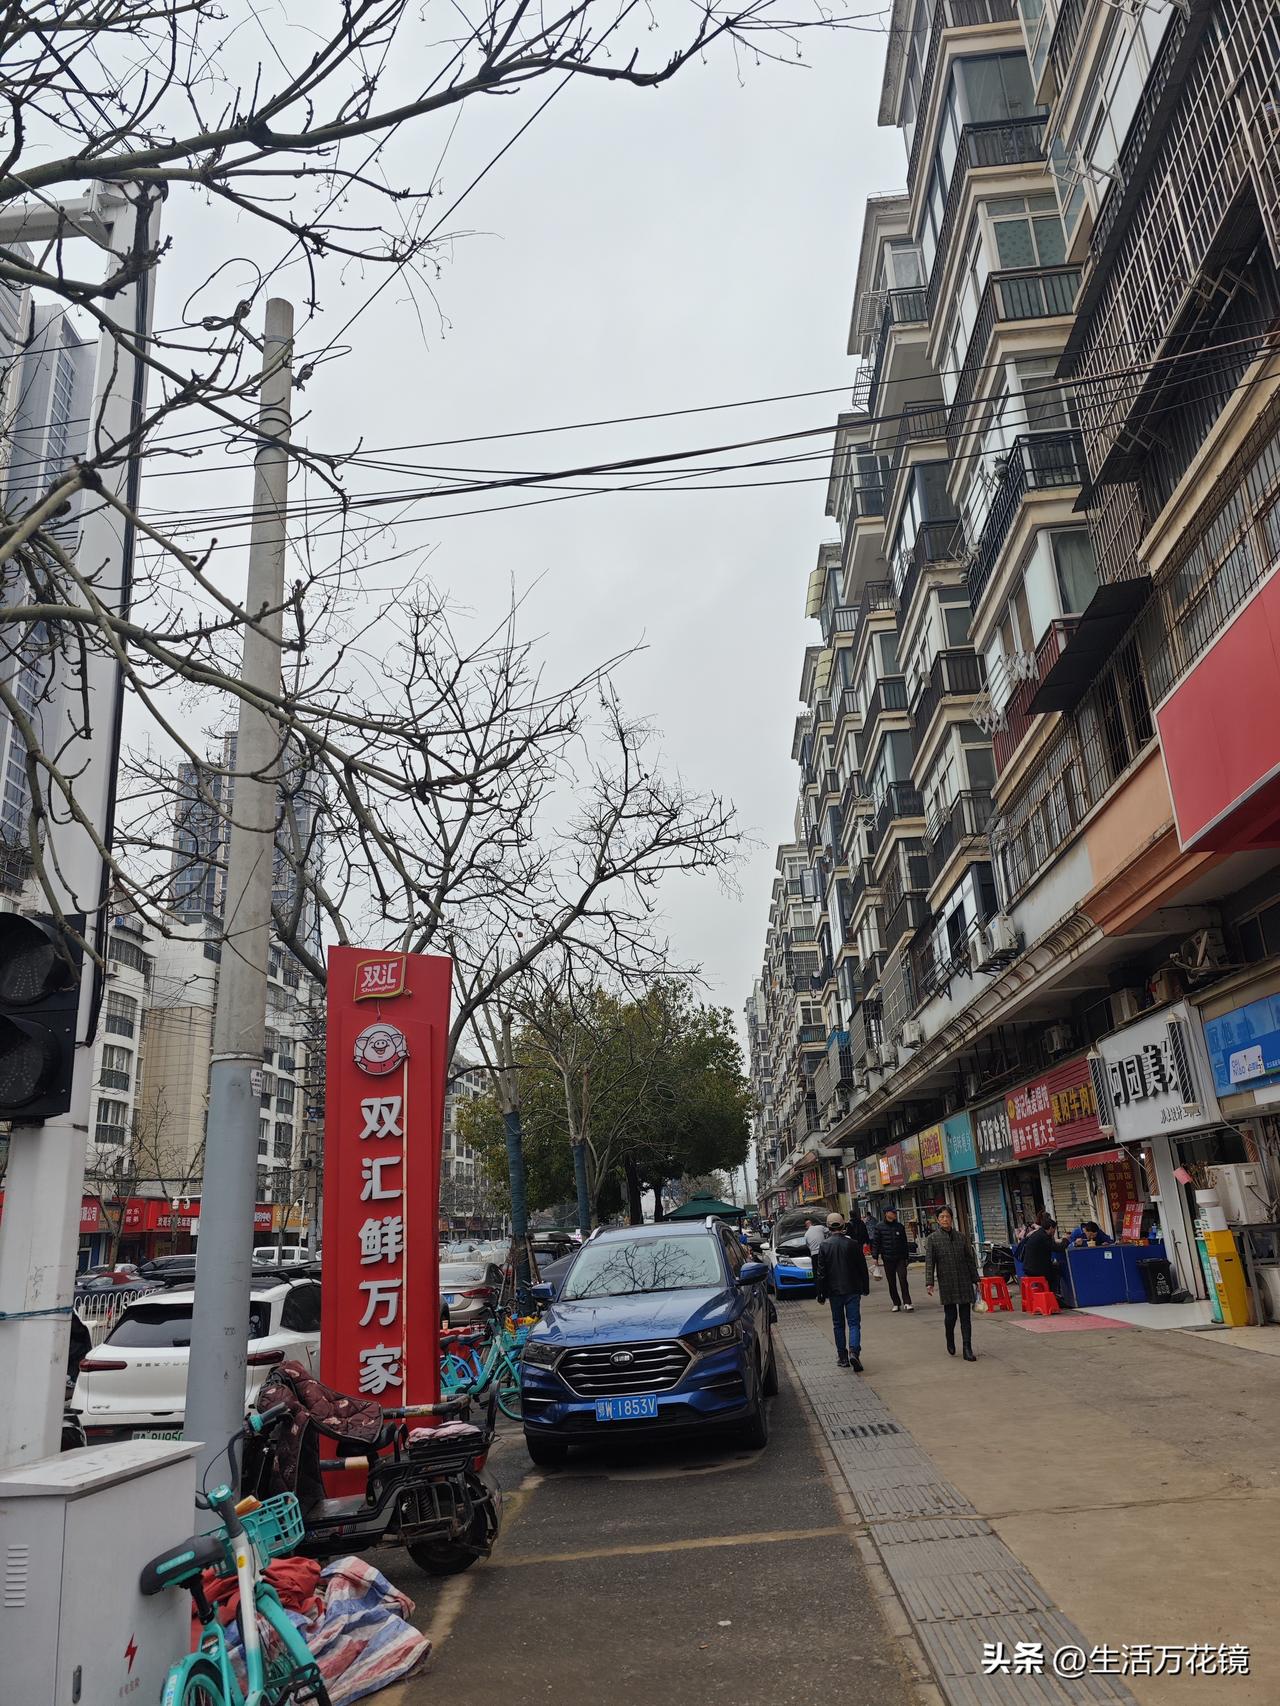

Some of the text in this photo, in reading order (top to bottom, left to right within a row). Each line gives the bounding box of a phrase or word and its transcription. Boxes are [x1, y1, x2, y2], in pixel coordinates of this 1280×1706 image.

[361, 962, 398, 988] 双汇
[357, 1095, 404, 1396] 双汇鲜万家
